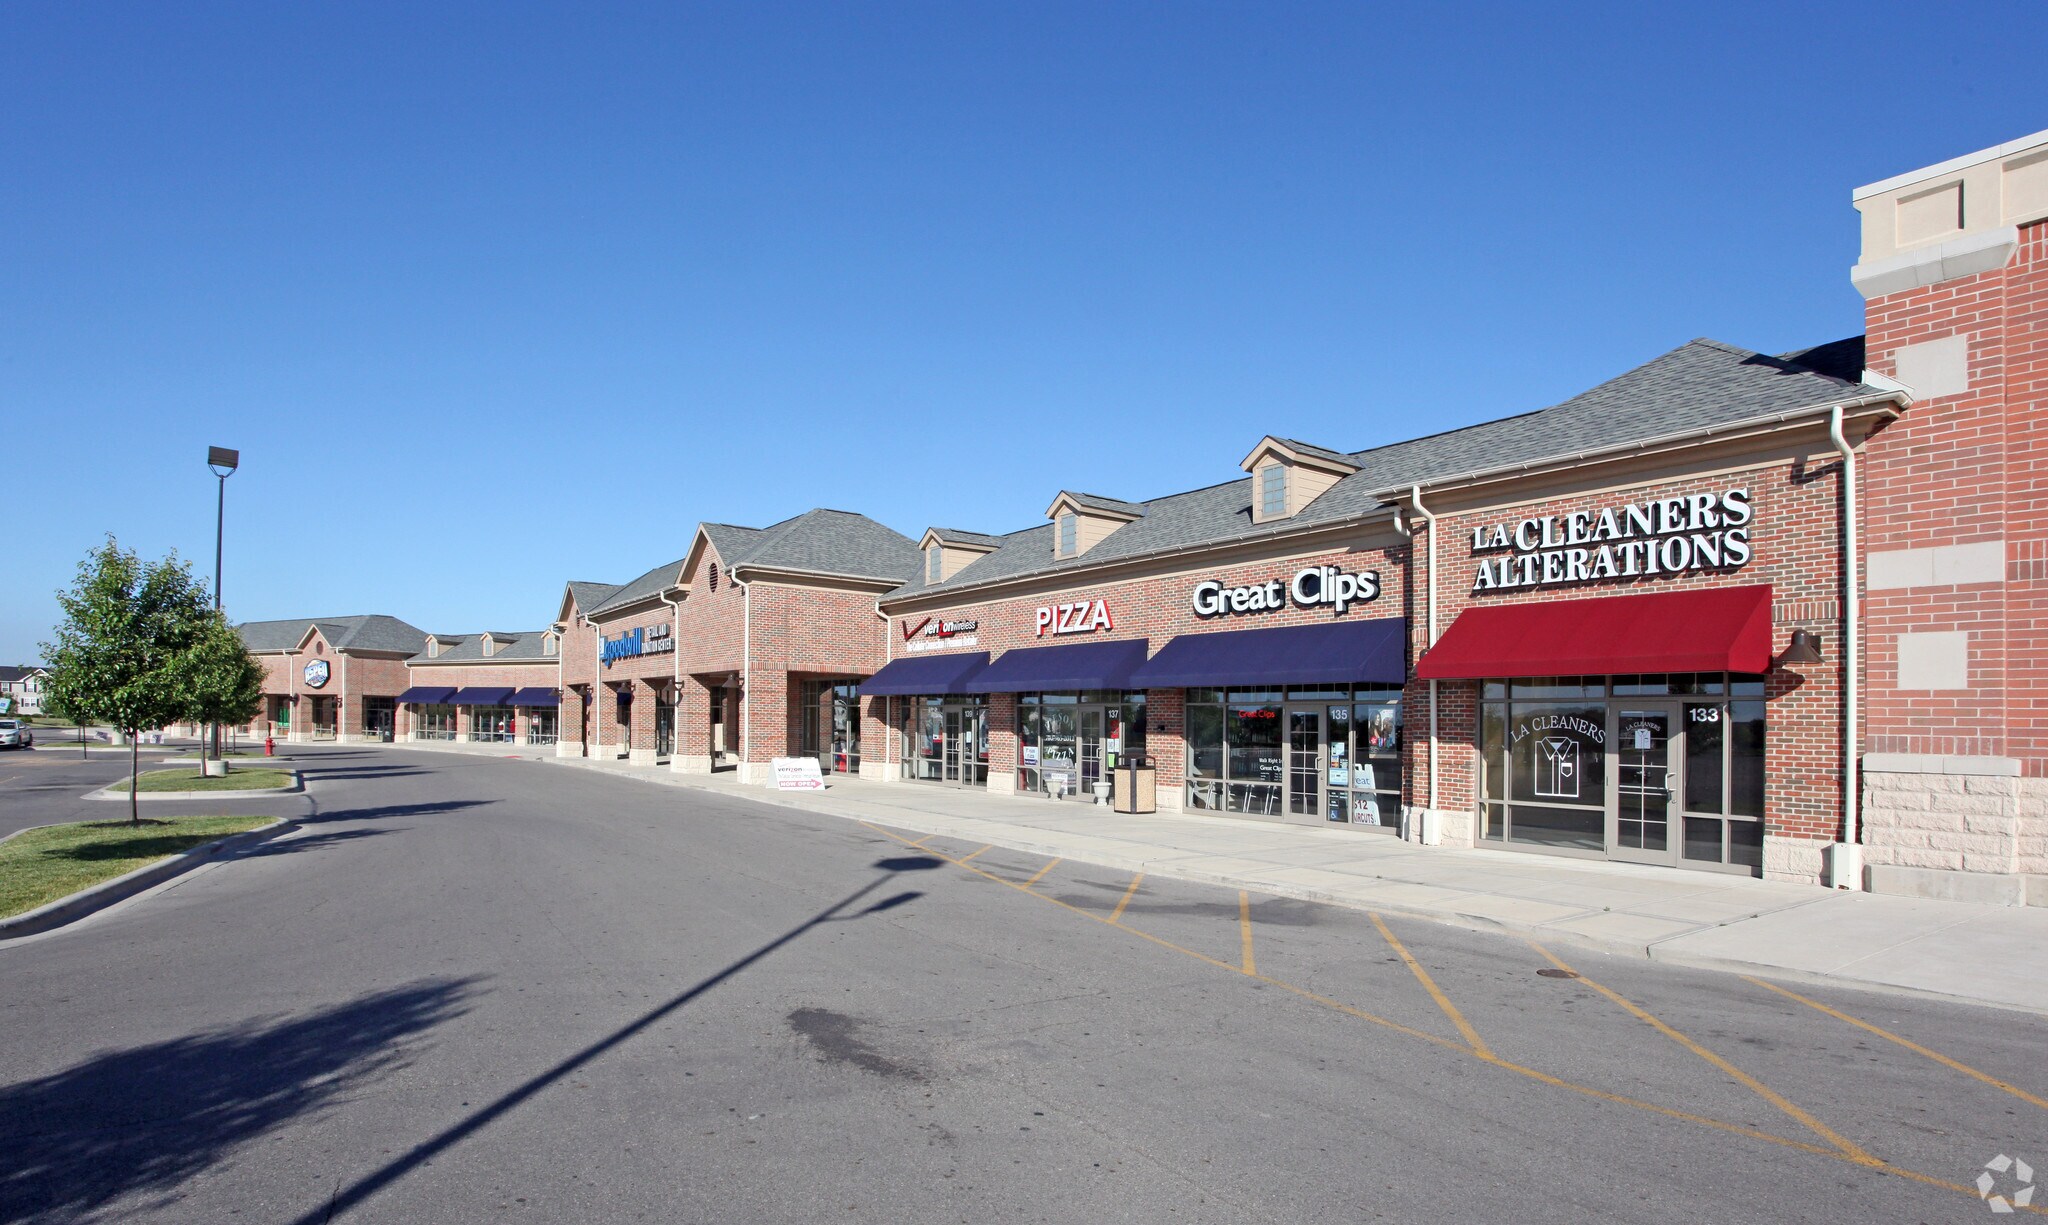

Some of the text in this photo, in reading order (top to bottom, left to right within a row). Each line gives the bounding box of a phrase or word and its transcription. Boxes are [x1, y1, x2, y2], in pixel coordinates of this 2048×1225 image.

[1473, 488, 1753, 551] LA CLEANERS
[1473, 527, 1752, 590] ALTERATIONS
[1193, 566, 1377, 615] Great Clips
[1036, 600, 1112, 636] PIZZA
[604, 627, 643, 666] goodwill
[1109, 710, 1119, 718] 137
[1239, 709, 1275, 719] Great Clips
[1331, 710, 1348, 720] 135
[1689, 708, 1719, 722] 133
[1511, 715, 1606, 744] LA CLEANERS
[1625, 721, 1661, 732] LA CLEANERS
[1047, 747, 1075, 760] PIZZA
